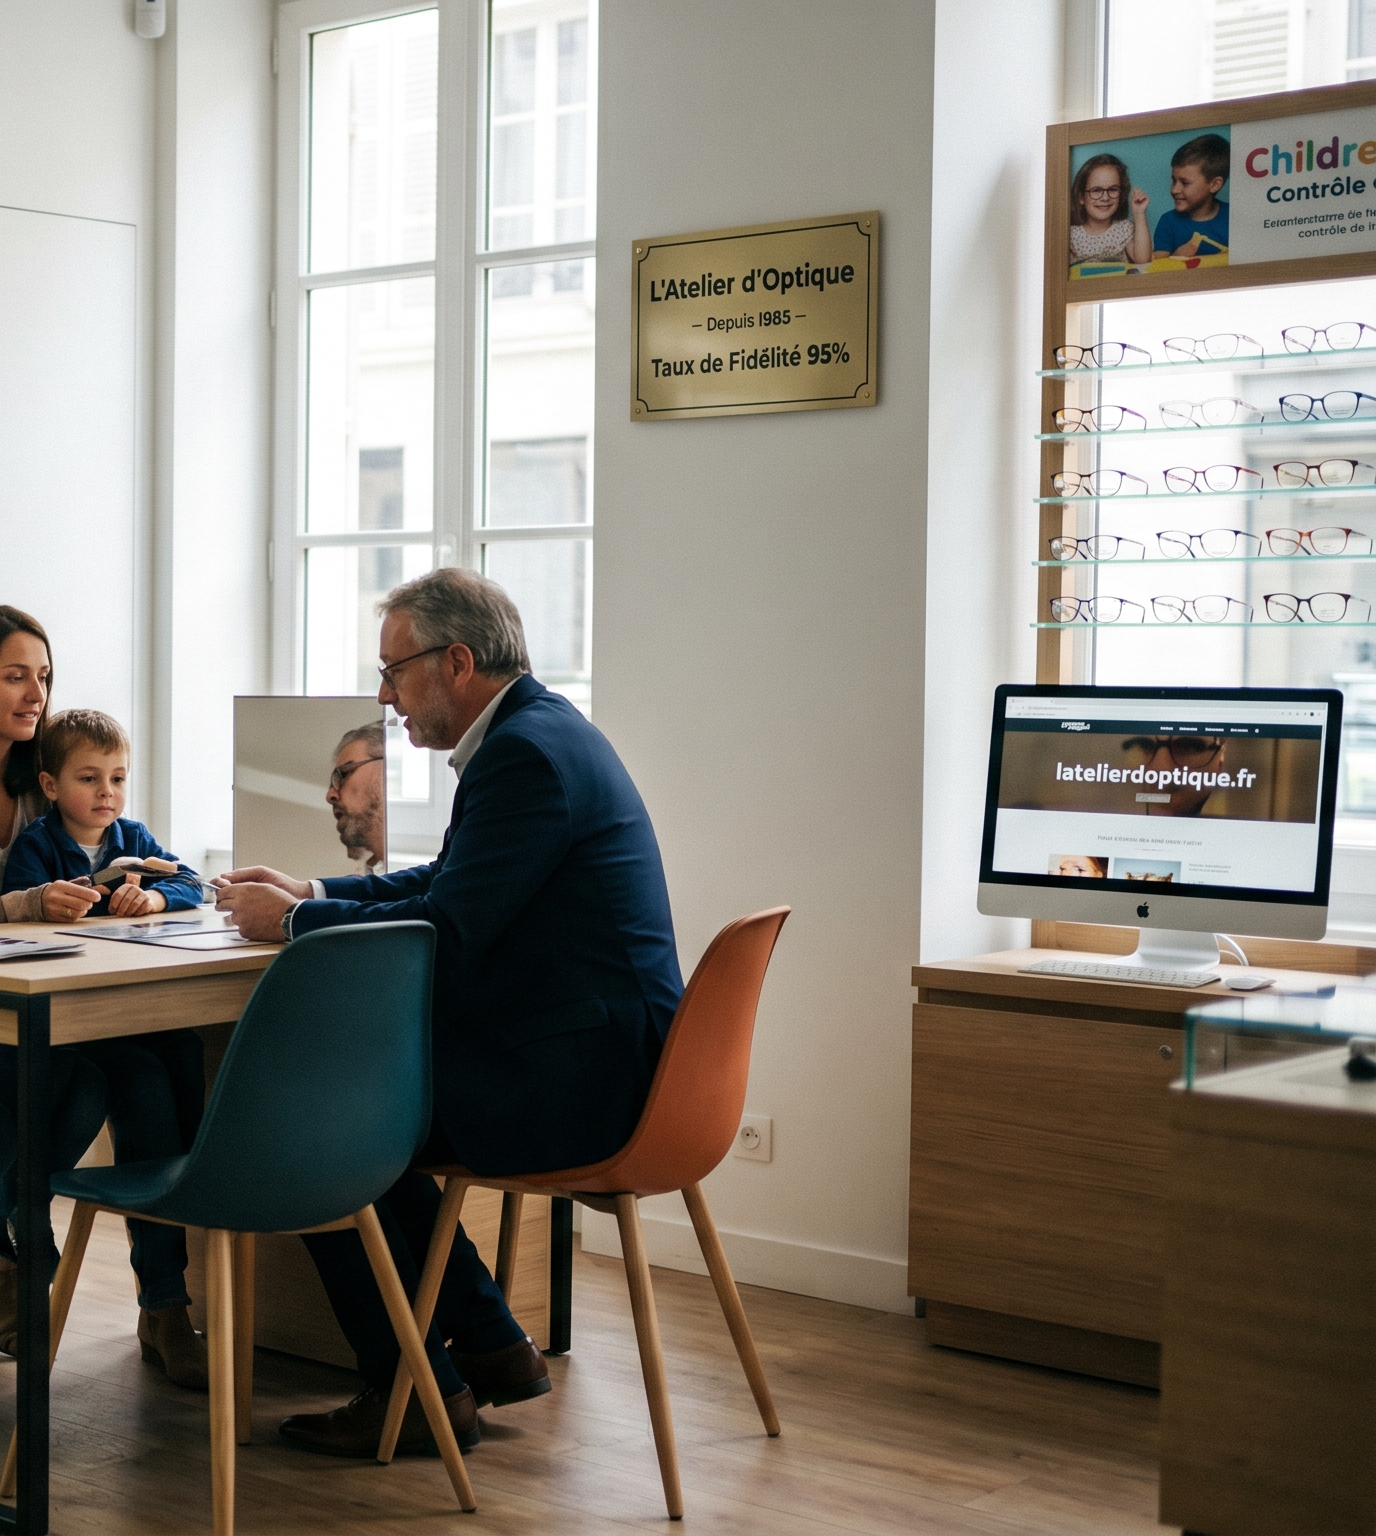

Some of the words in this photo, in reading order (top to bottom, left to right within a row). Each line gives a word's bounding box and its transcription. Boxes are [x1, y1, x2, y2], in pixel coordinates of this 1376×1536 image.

[1245, 136, 1376, 178] Childre
[1266, 175, 1366, 203] Contrôle
[1350, 223, 1365, 233] de
[650, 272, 735, 302] L'Atelier
[741, 262, 855, 295] d'Optique
[707, 313, 755, 333] Depuis
[759, 310, 792, 327] 1985
[651, 357, 695, 378] Taux
[700, 352, 724, 374] de
[807, 342, 851, 366] 95%
[1055, 762, 1257, 791] latelierdoptique.fr
